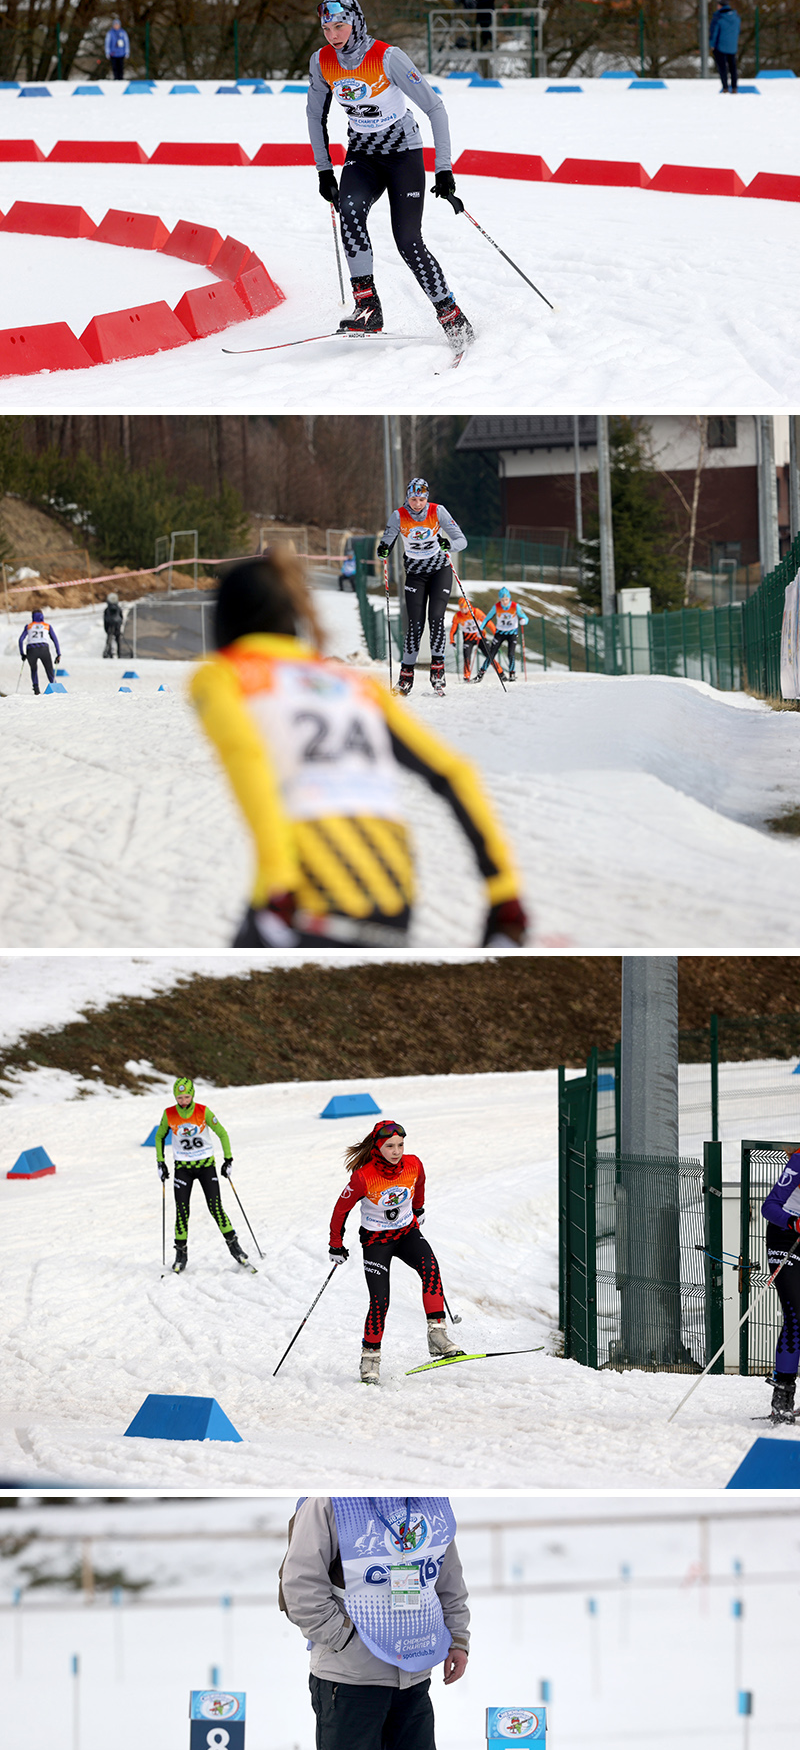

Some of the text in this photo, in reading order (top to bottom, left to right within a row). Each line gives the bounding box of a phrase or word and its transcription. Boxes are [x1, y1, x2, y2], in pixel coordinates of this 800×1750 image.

[409, 540, 436, 551] 22
[293, 709, 377, 764] 24
[180, 1137, 204, 1150] 26
[402, 1650, 435, 1661] sportclub.by
